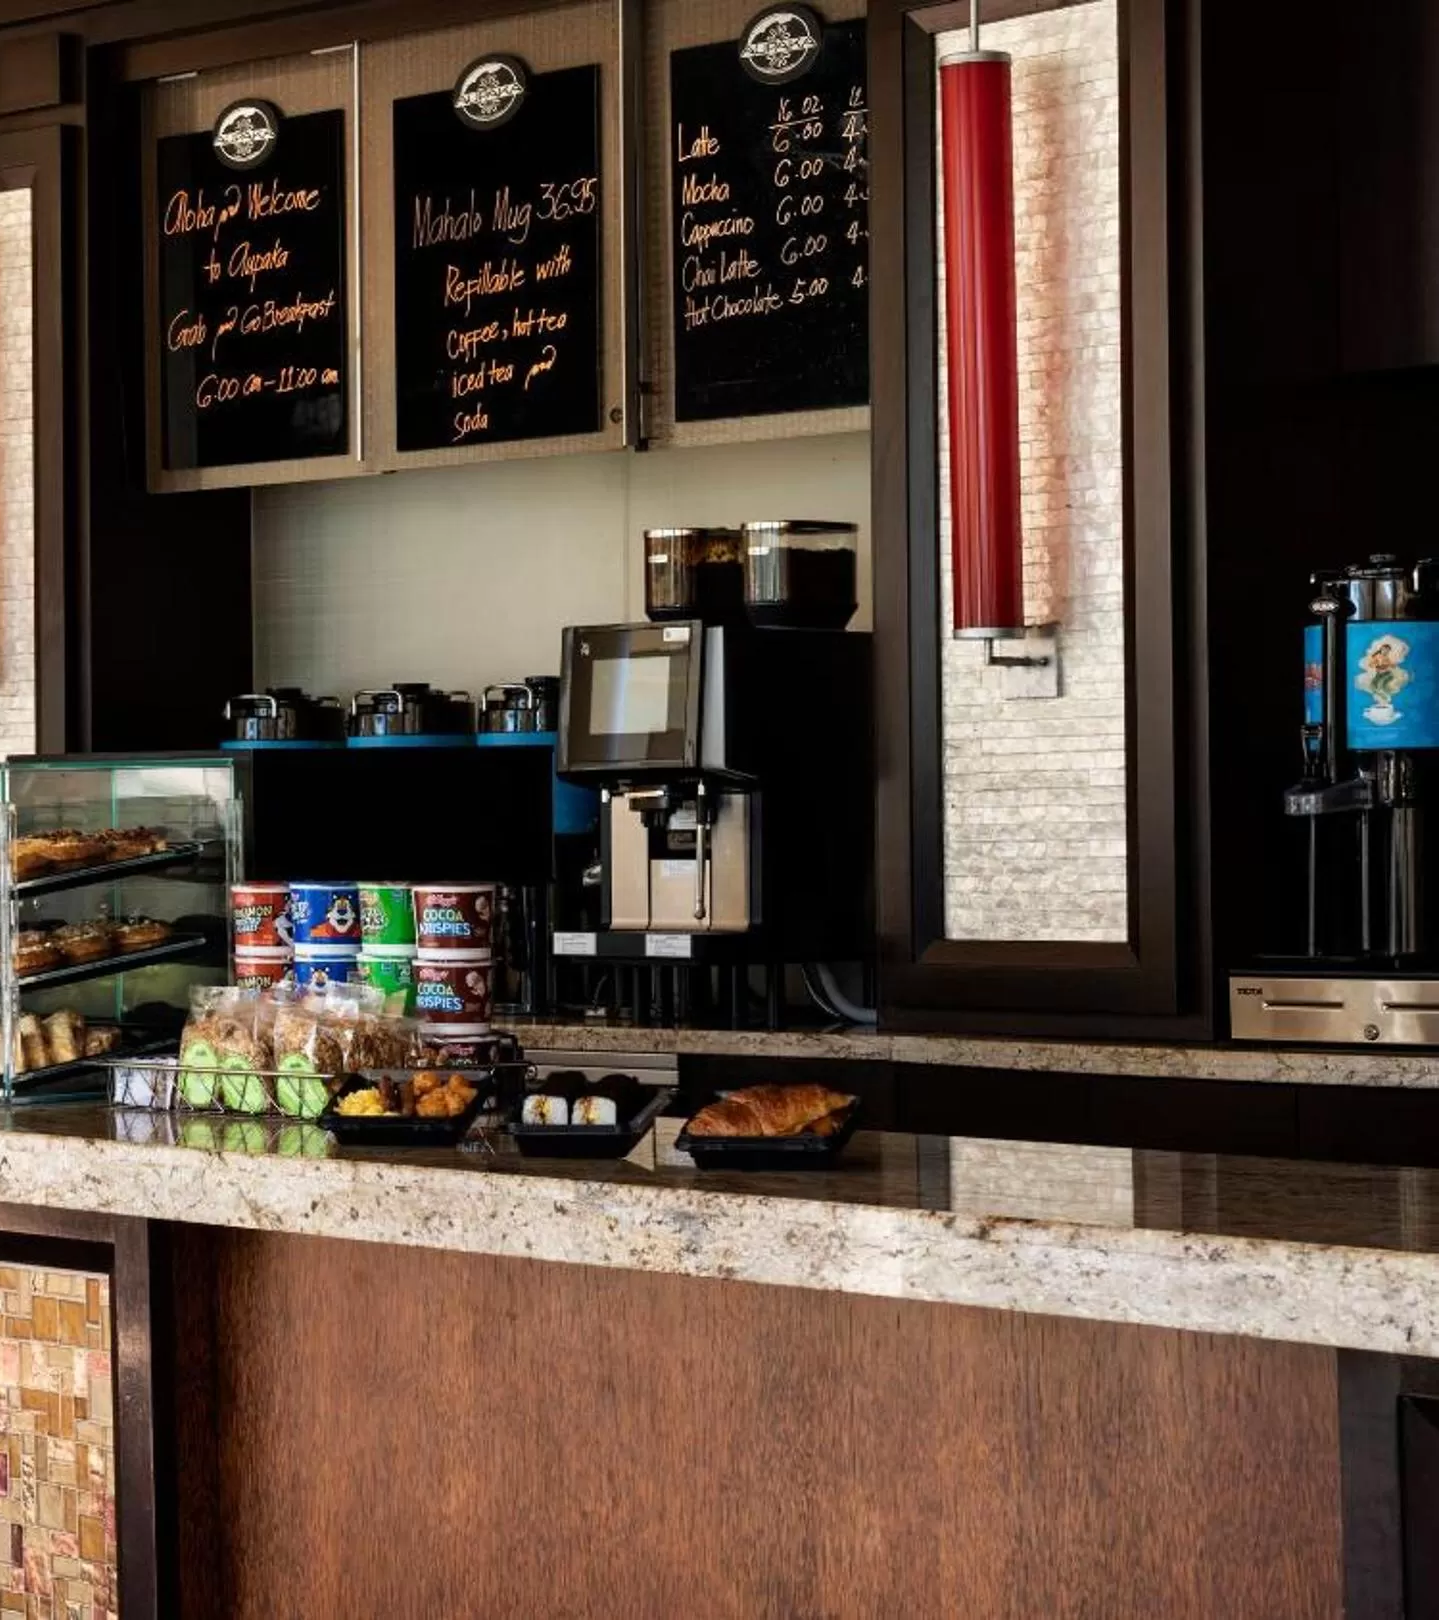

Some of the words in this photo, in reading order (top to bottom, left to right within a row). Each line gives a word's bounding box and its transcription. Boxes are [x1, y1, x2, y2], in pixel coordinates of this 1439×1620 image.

[678, 122, 720, 163] Latte
[682, 172, 730, 207] Mocha
[773, 158, 824, 188] 6.00
[164, 188, 216, 235] Aloha
[248, 177, 321, 220] Welcome
[413, 188, 482, 249] Mahalo
[492, 185, 533, 244] Mug
[536, 177, 598, 220] 36.95
[681, 208, 755, 254] Cappuccino
[776, 195, 824, 226] 6.00
[203, 248, 221, 284] to
[444, 257, 526, 318] Refillable
[536, 244, 572, 282] with
[720, 249, 761, 284] Latte
[780, 234, 827, 265] 6.00
[512, 307, 535, 337] hot
[536, 308, 568, 334] tea
[684, 296, 710, 332] Hot
[711, 283, 784, 321] Chocolate
[788, 277, 830, 304] 5.00
[167, 308, 207, 352] Grab
[196, 373, 240, 407] 6:00
[451, 361, 486, 398] iced
[487, 358, 515, 385] tea
[423, 908, 464, 922] COCOA
[417, 983, 454, 995] COCOA
